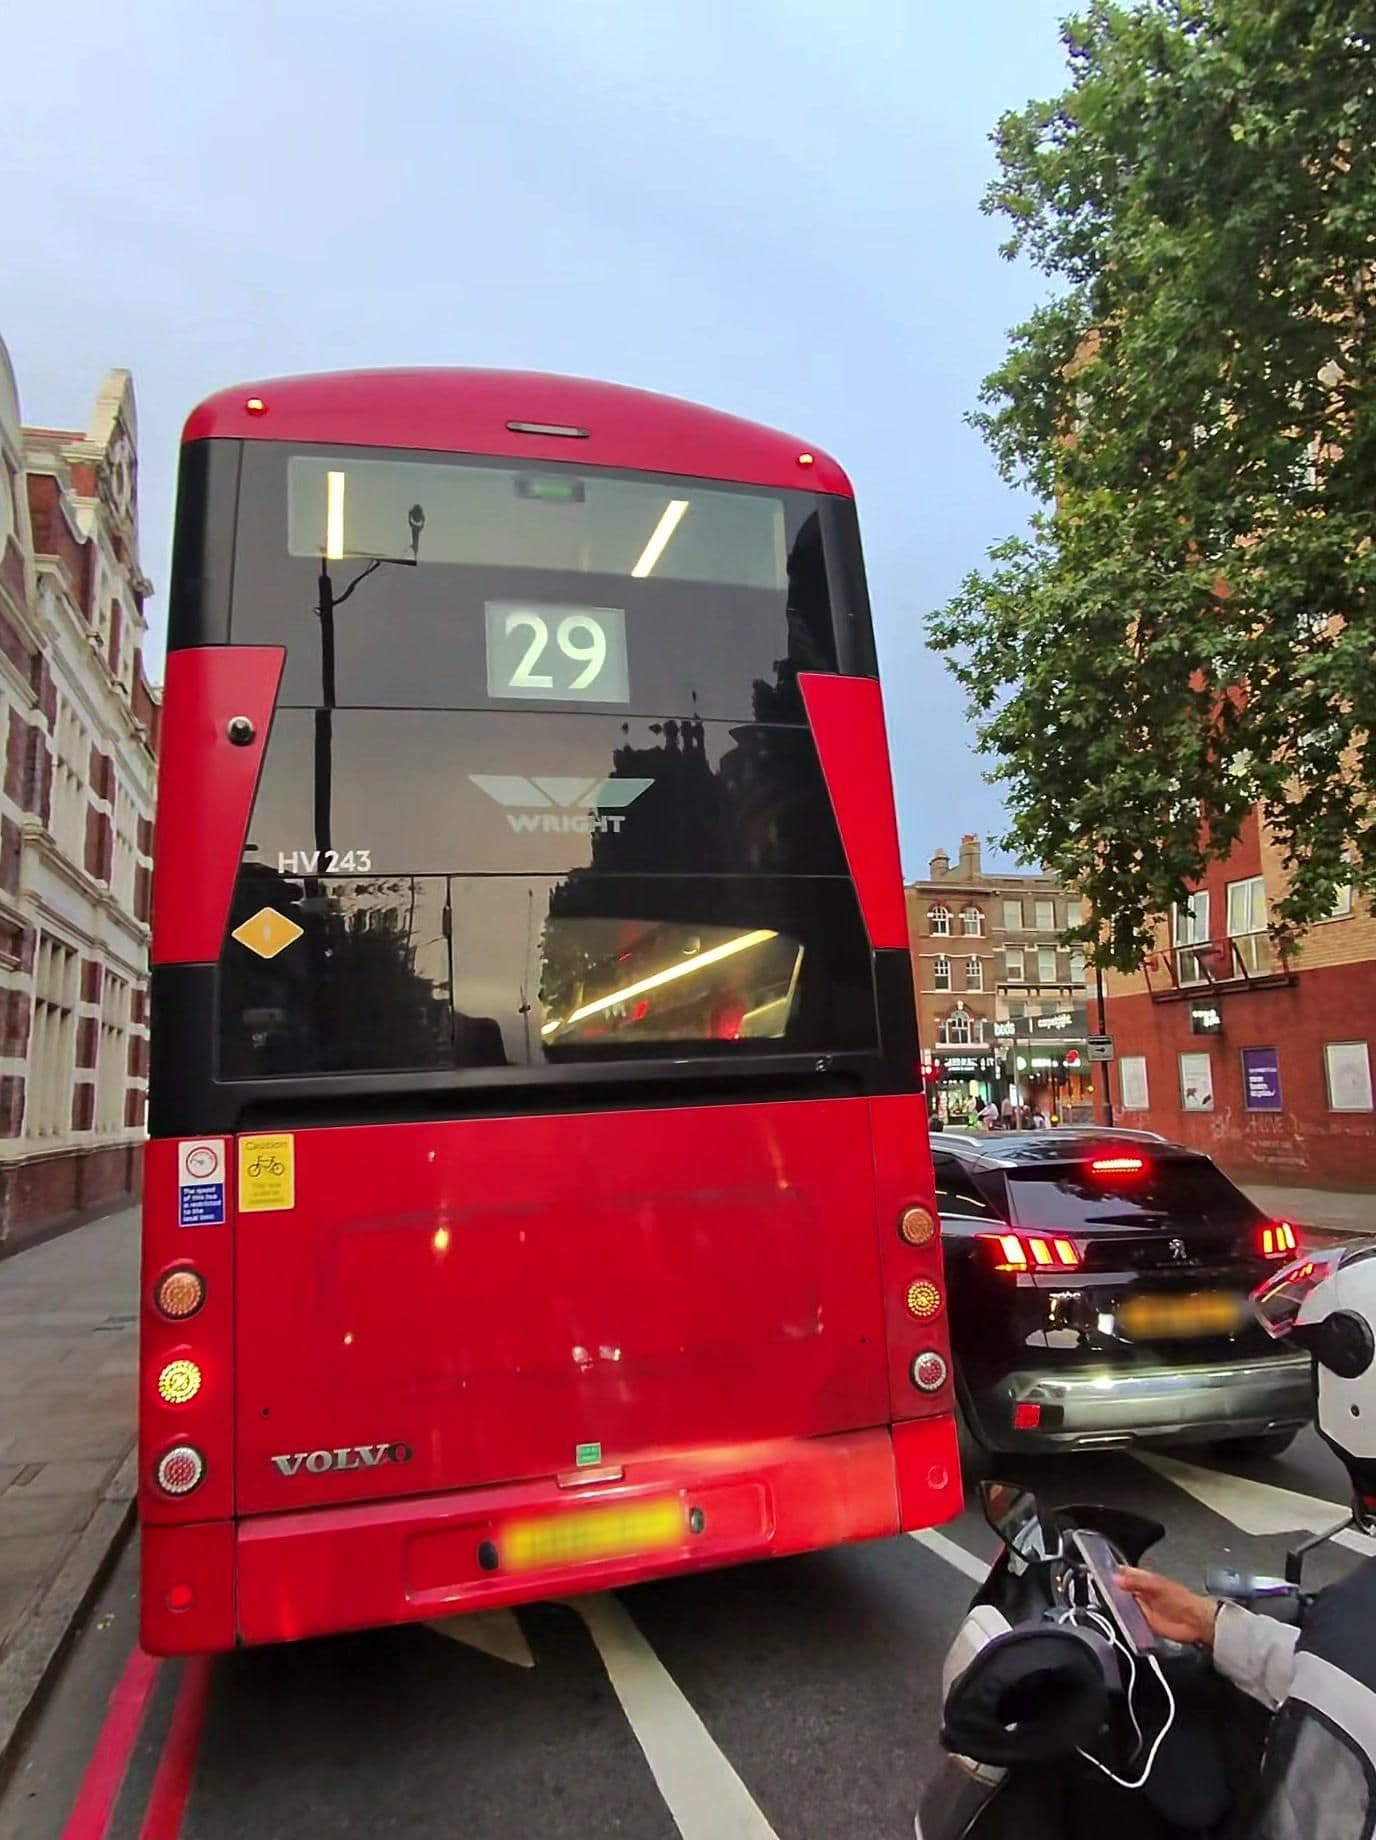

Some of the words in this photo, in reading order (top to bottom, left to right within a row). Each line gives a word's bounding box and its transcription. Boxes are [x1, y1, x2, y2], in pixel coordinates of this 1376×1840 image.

[505, 610, 607, 690] 29
[505, 814, 626, 833] WRIGHT
[271, 1441, 413, 1476] VOLVO
